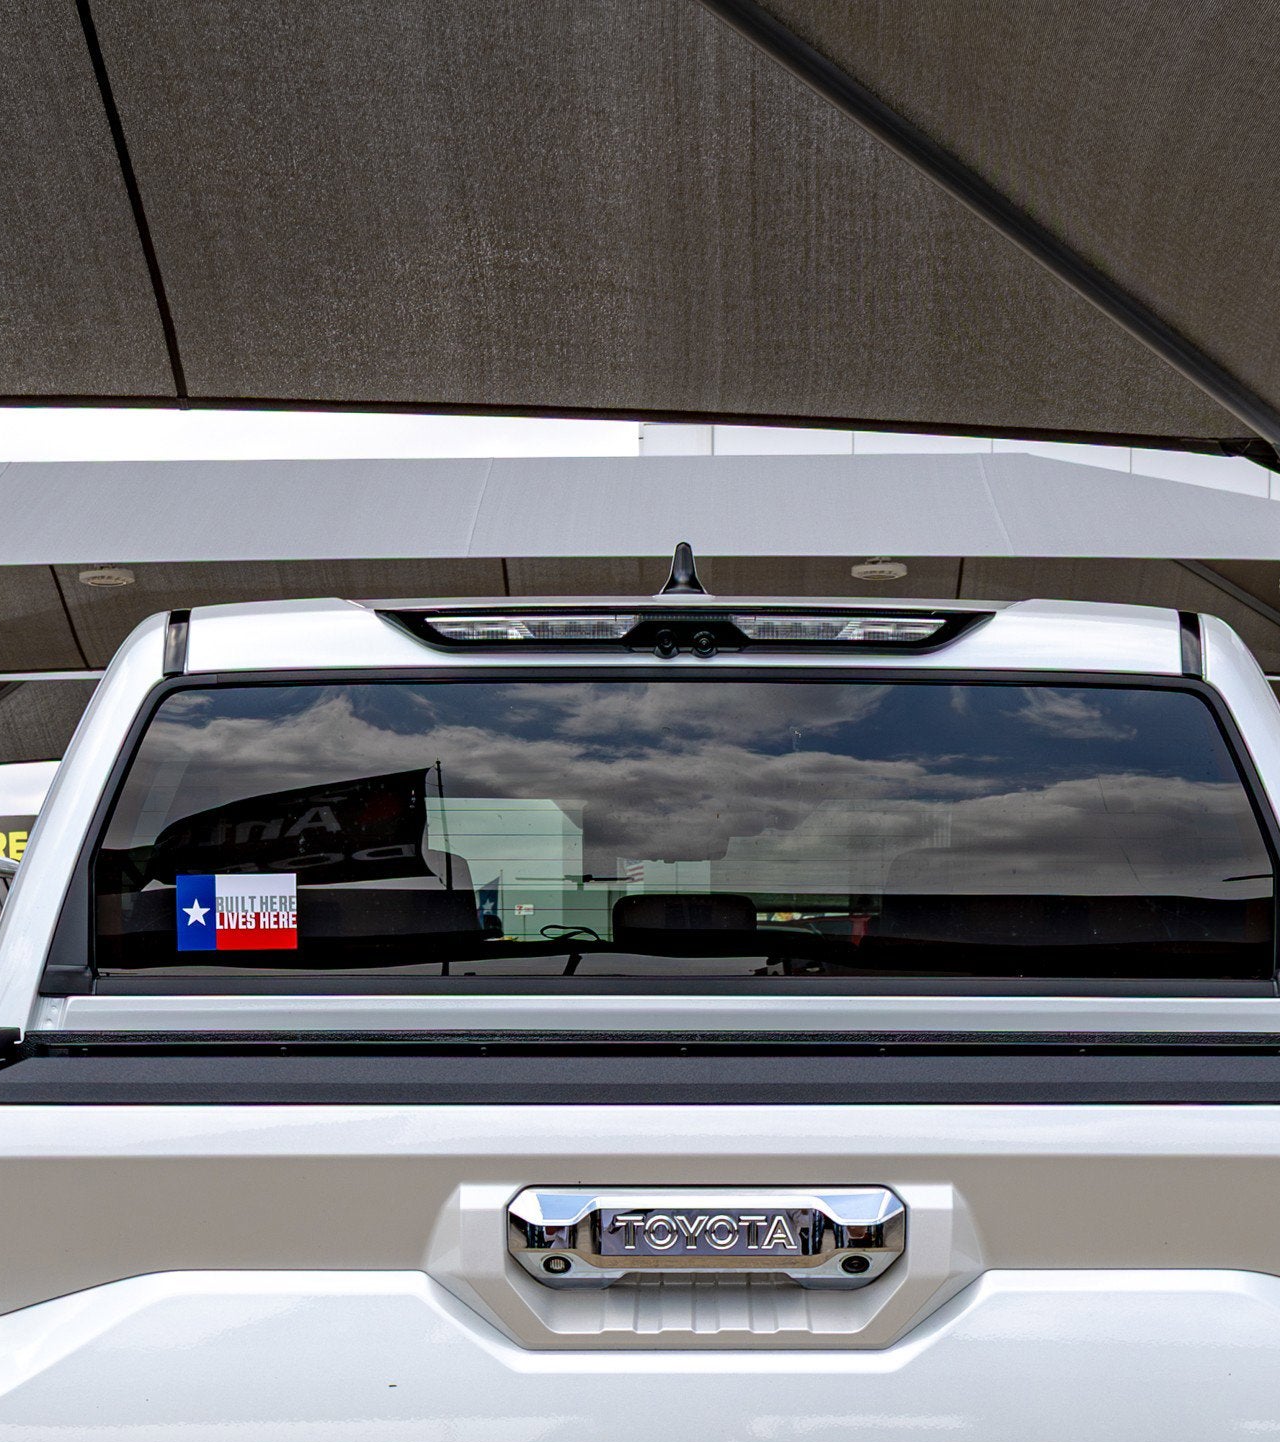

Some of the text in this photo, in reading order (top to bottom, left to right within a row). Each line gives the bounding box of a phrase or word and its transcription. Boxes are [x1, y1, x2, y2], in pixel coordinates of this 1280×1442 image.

[216, 895, 297, 913] BUILT HERE
[216, 911, 297, 930] LIVES HERE
[616, 1215, 798, 1250] TOYOTA
